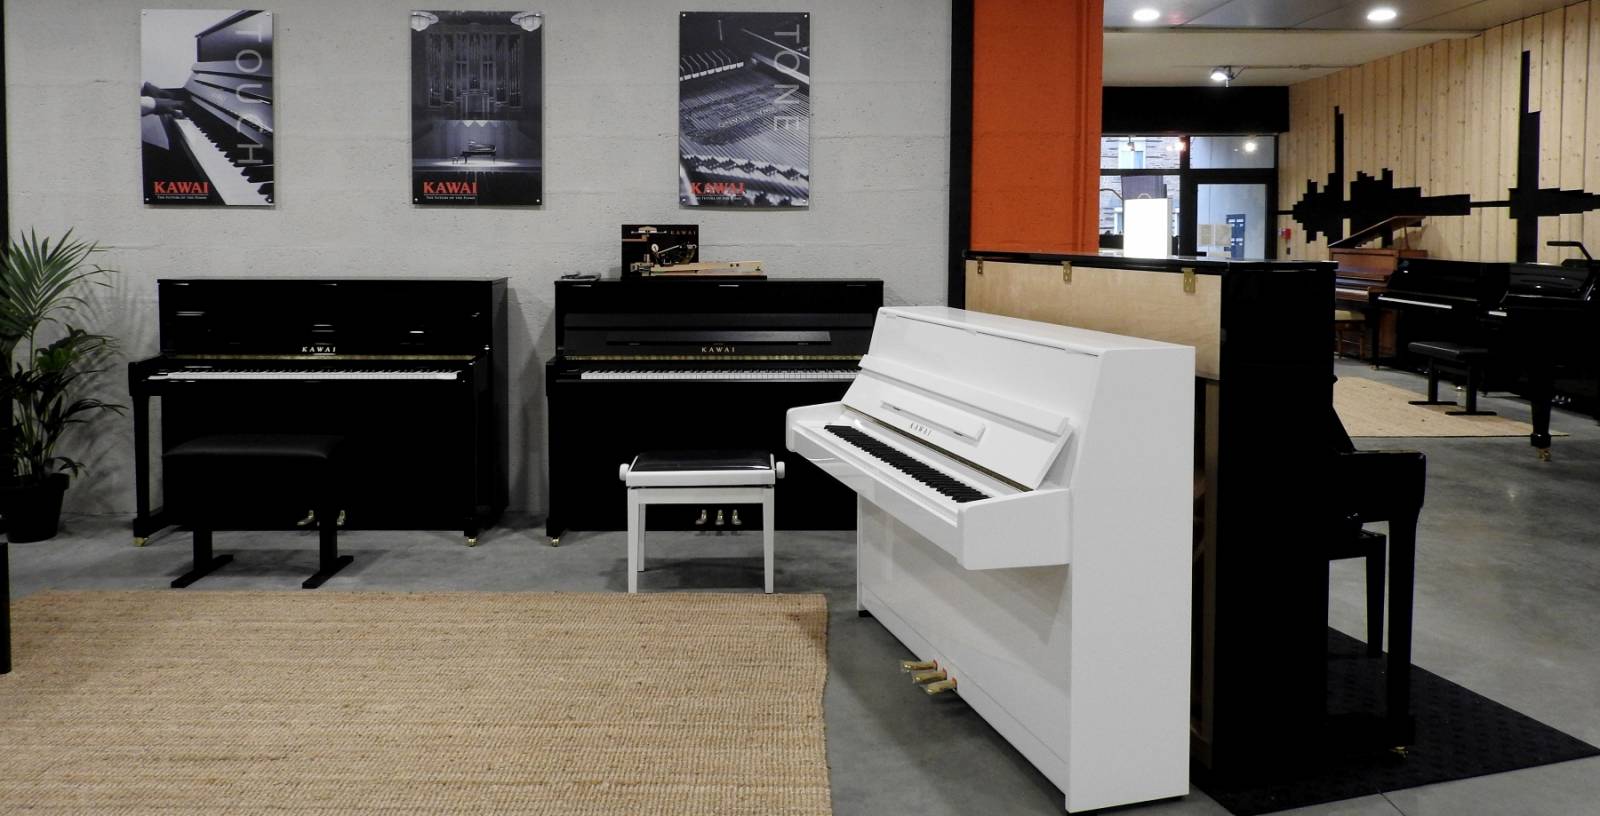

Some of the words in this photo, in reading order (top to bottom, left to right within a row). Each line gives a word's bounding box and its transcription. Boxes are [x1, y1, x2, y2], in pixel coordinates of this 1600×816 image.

[773, 23, 800, 131] TONE
[235, 24, 263, 164] TOUCH
[153, 181, 209, 193] KAWAI
[423, 181, 478, 193] KAWAI
[690, 182, 745, 194] KAWAI
